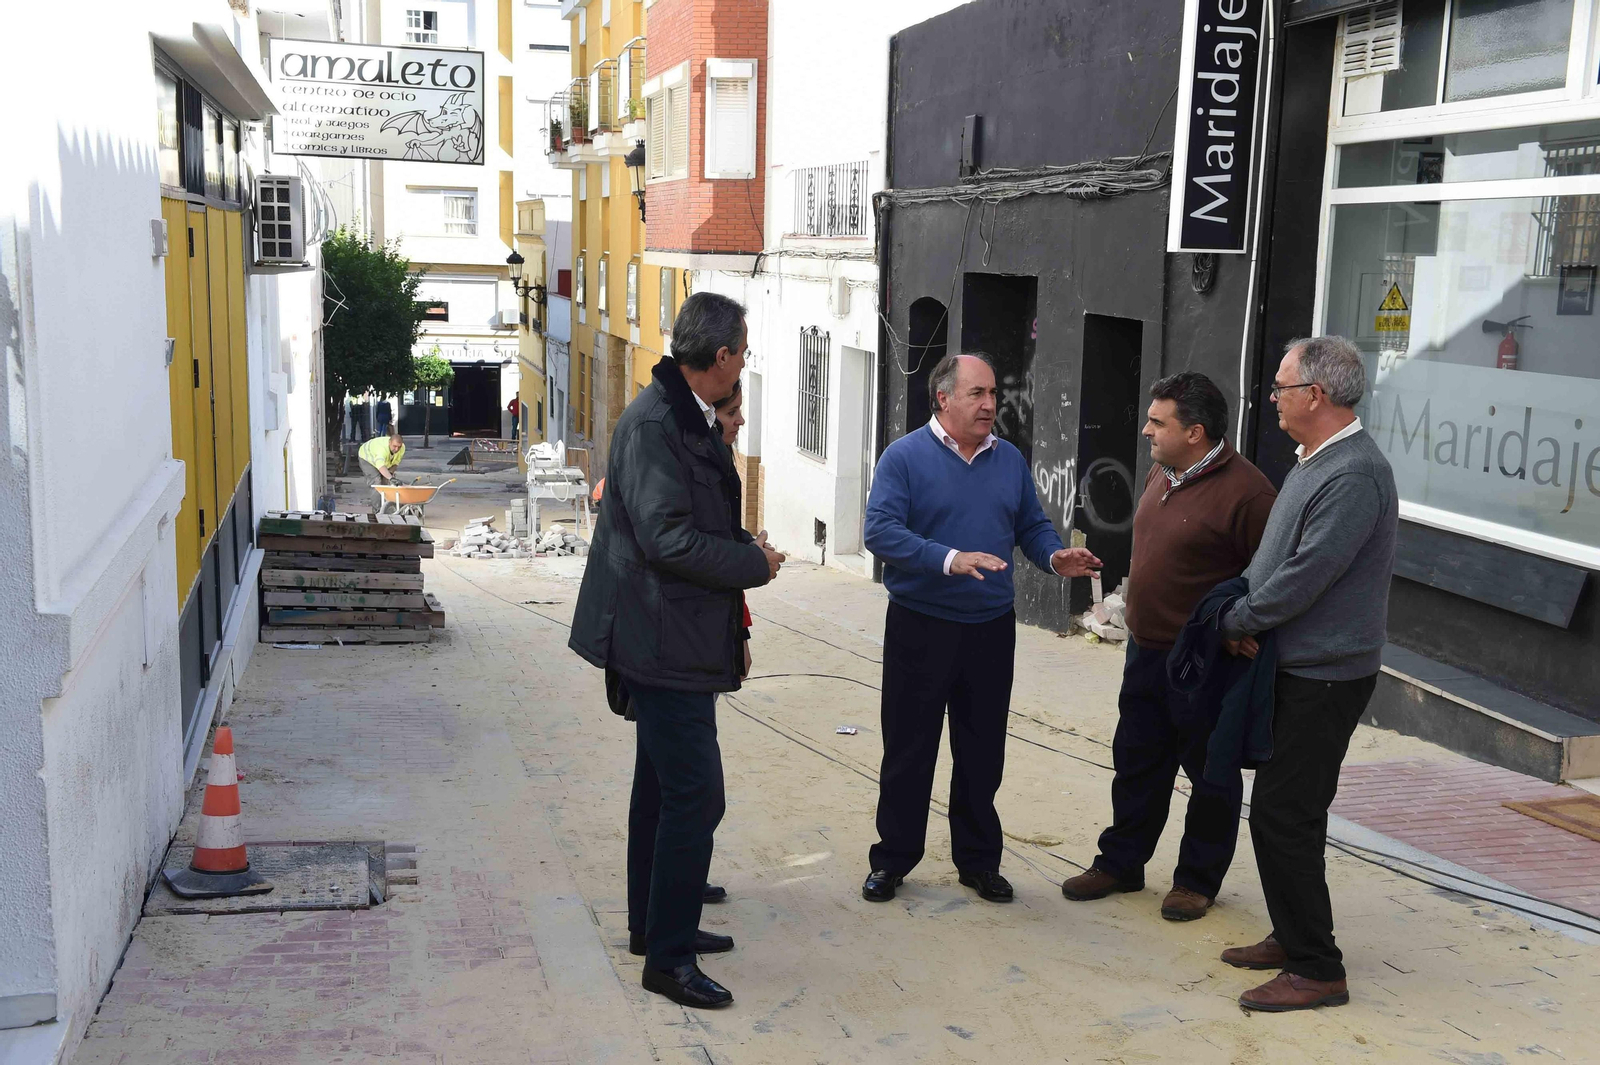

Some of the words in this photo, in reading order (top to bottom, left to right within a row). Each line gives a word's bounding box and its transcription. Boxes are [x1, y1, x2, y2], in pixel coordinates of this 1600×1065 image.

[280, 51, 476, 89] amuleto
[1190, 0, 1257, 223] Maridaje
[1388, 395, 1600, 514] Maridaje
